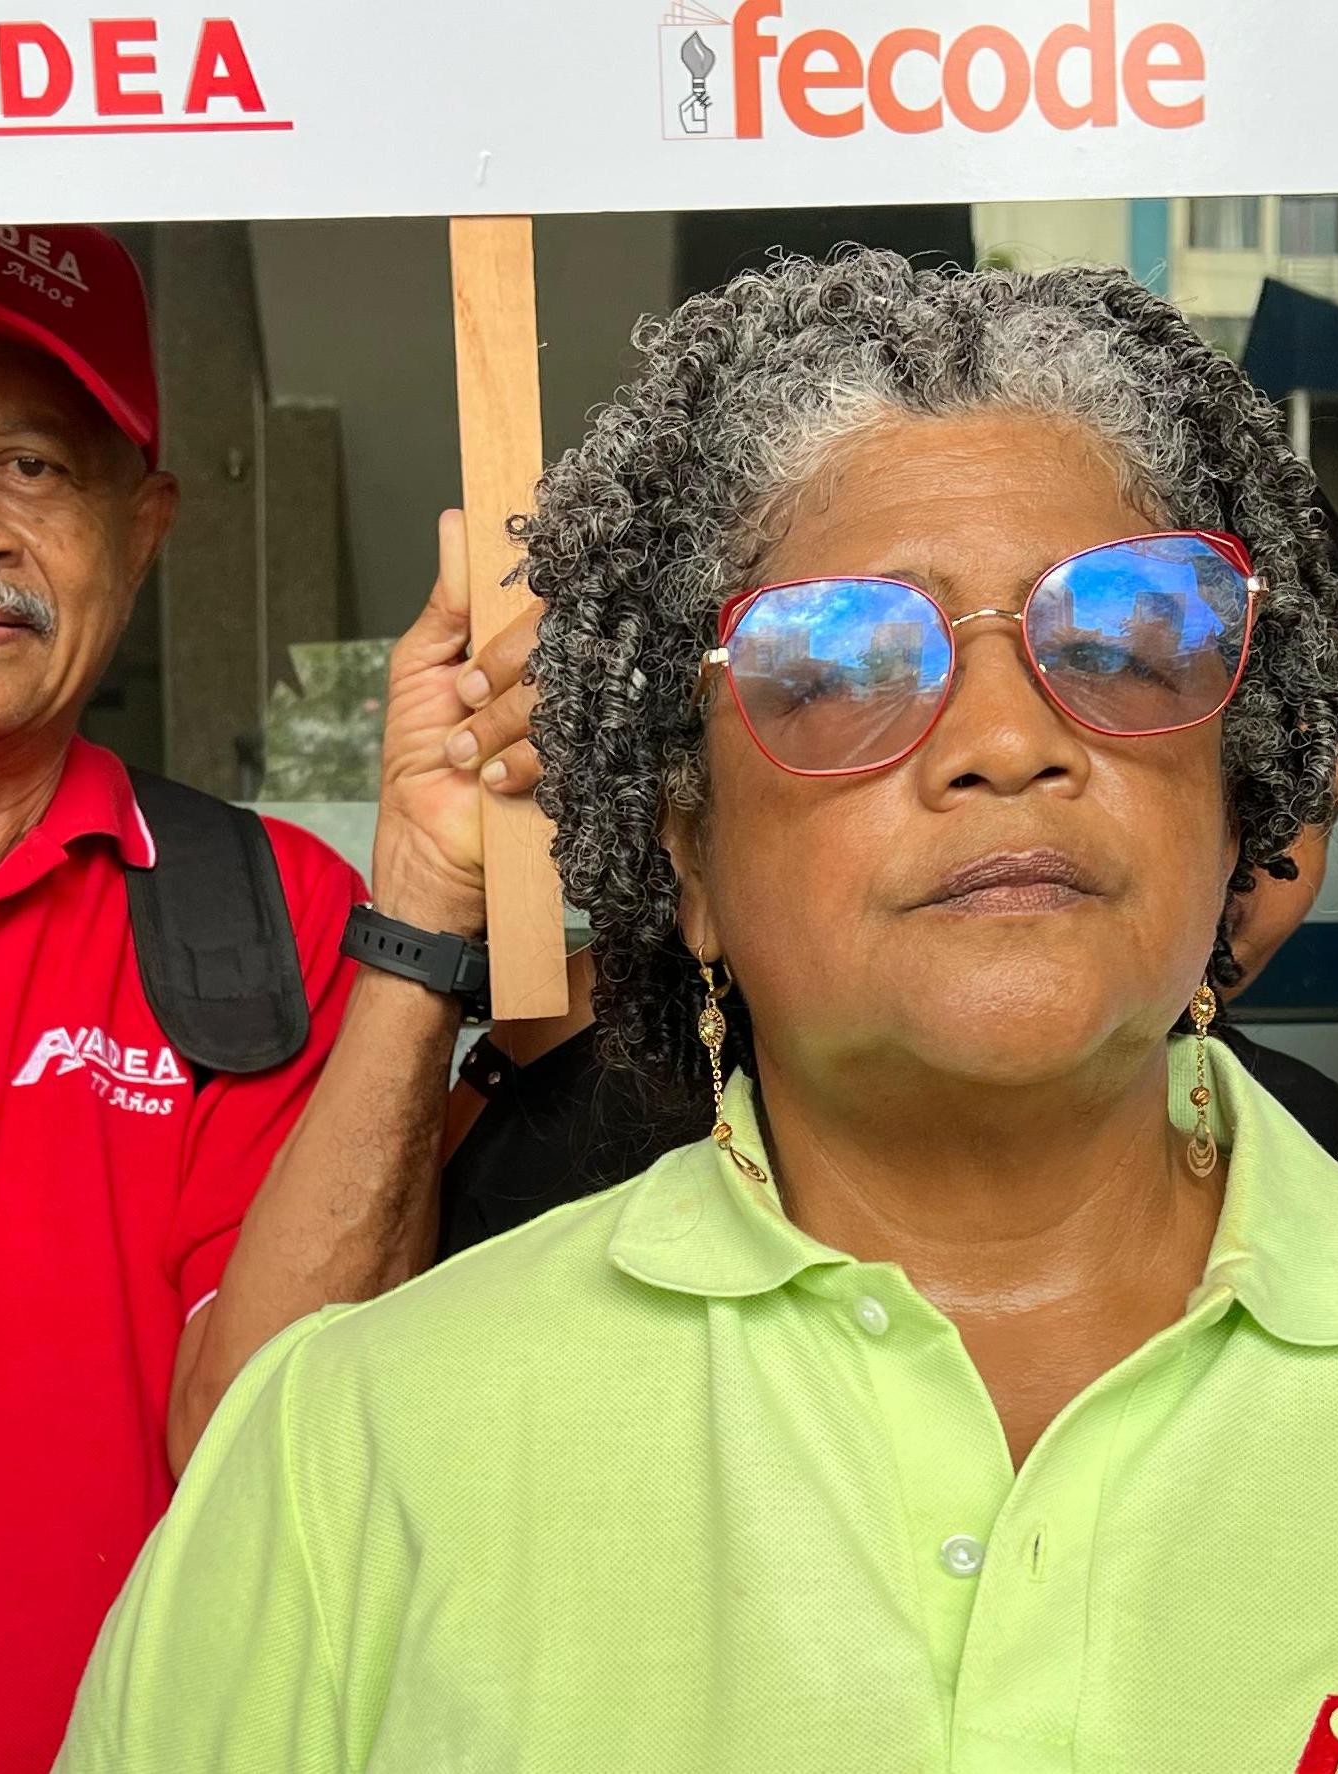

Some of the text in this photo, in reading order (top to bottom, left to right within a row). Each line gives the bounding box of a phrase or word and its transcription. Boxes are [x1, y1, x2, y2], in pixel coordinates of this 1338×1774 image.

[734, 0, 1204, 139] fecode
[1, 261, 75, 308] Años
[91, 1070, 174, 1115] 77 Años
